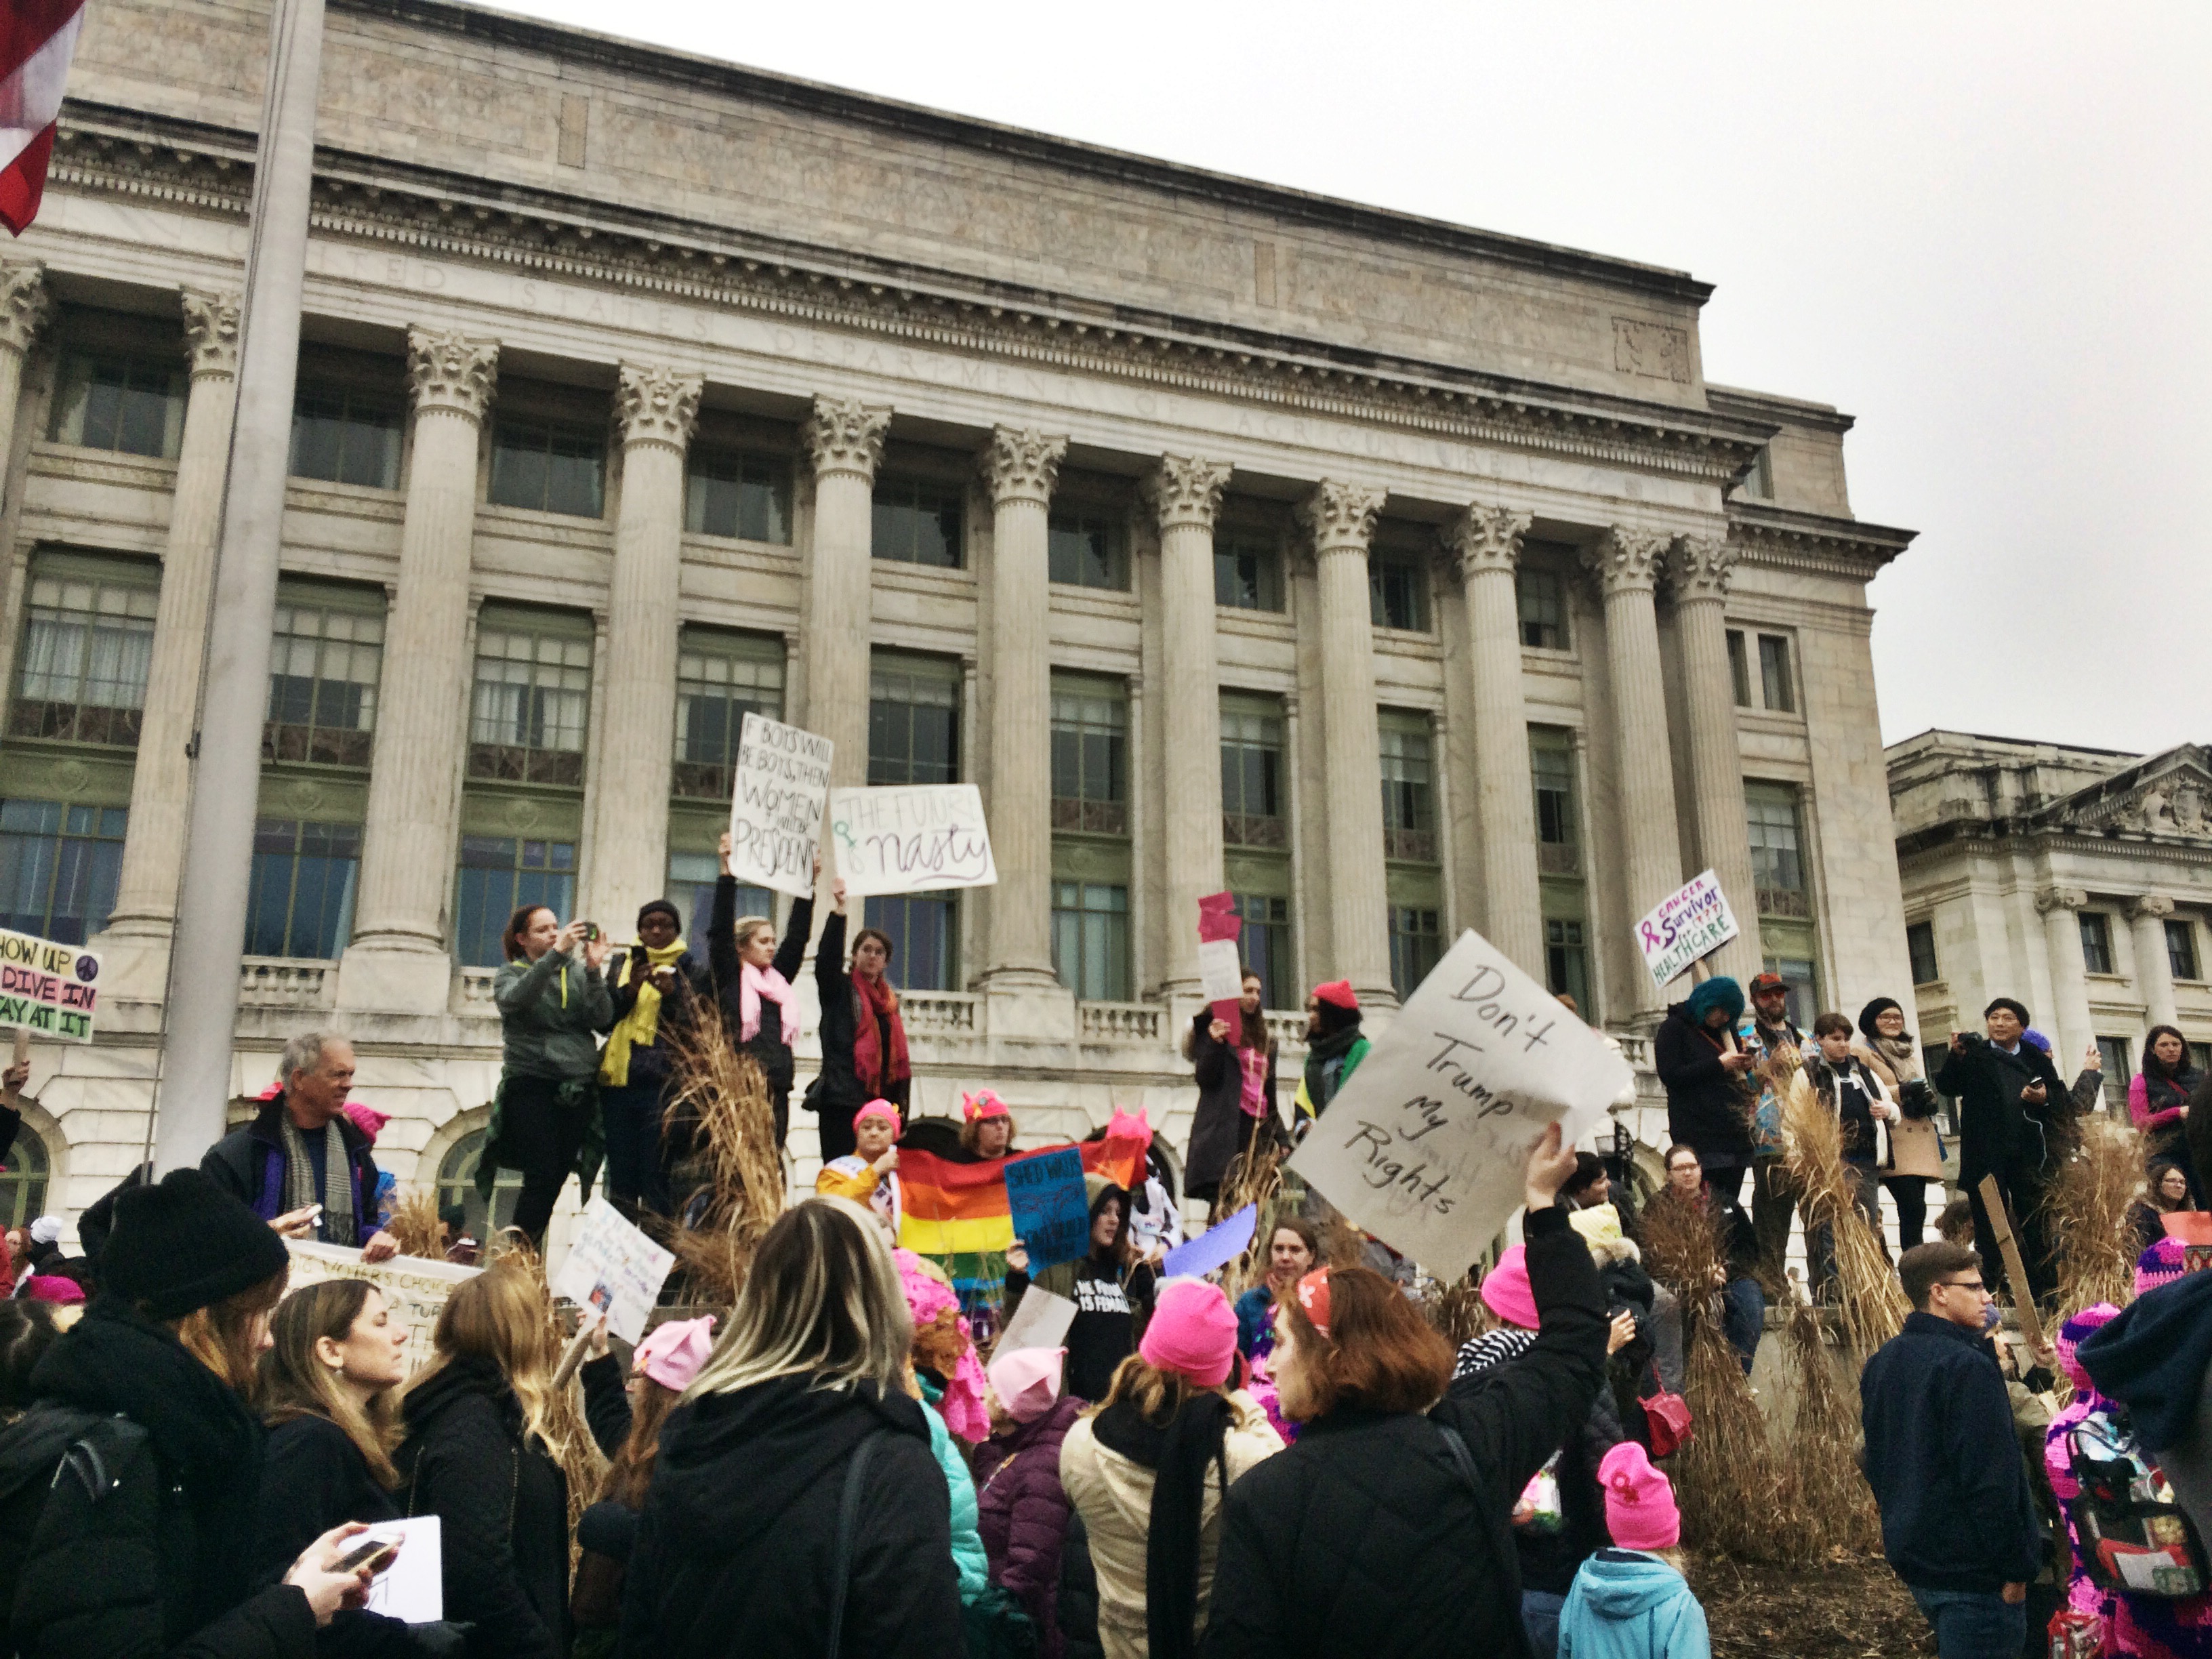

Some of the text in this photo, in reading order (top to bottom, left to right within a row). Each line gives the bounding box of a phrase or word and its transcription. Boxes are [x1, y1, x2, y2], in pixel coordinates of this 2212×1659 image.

[226, 226, 1502, 476] UITED STATES DEPARTMENT OF AGRICULTURE
[760, 722, 800, 754] BOYS
[800, 735, 830, 763] WILL
[741, 744, 755, 768] BE
[796, 760, 830, 788] THEN
[742, 773, 822, 822] WOMEN
[837, 790, 981, 830] THE FUTURE
[1658, 880, 1704, 919] CANCER
[0, 935, 71, 975] HOW UP
[1, 964, 96, 1009] DIVE IN
[1450, 964, 1556, 1052] Don't
[28, 1004, 56, 1029] AT
[59, 1011, 91, 1038] IT
[1427, 1031, 1515, 1120] Trump
[1344, 1120, 1458, 1215] Rights
[1079, 1294, 1094, 1312] IS
